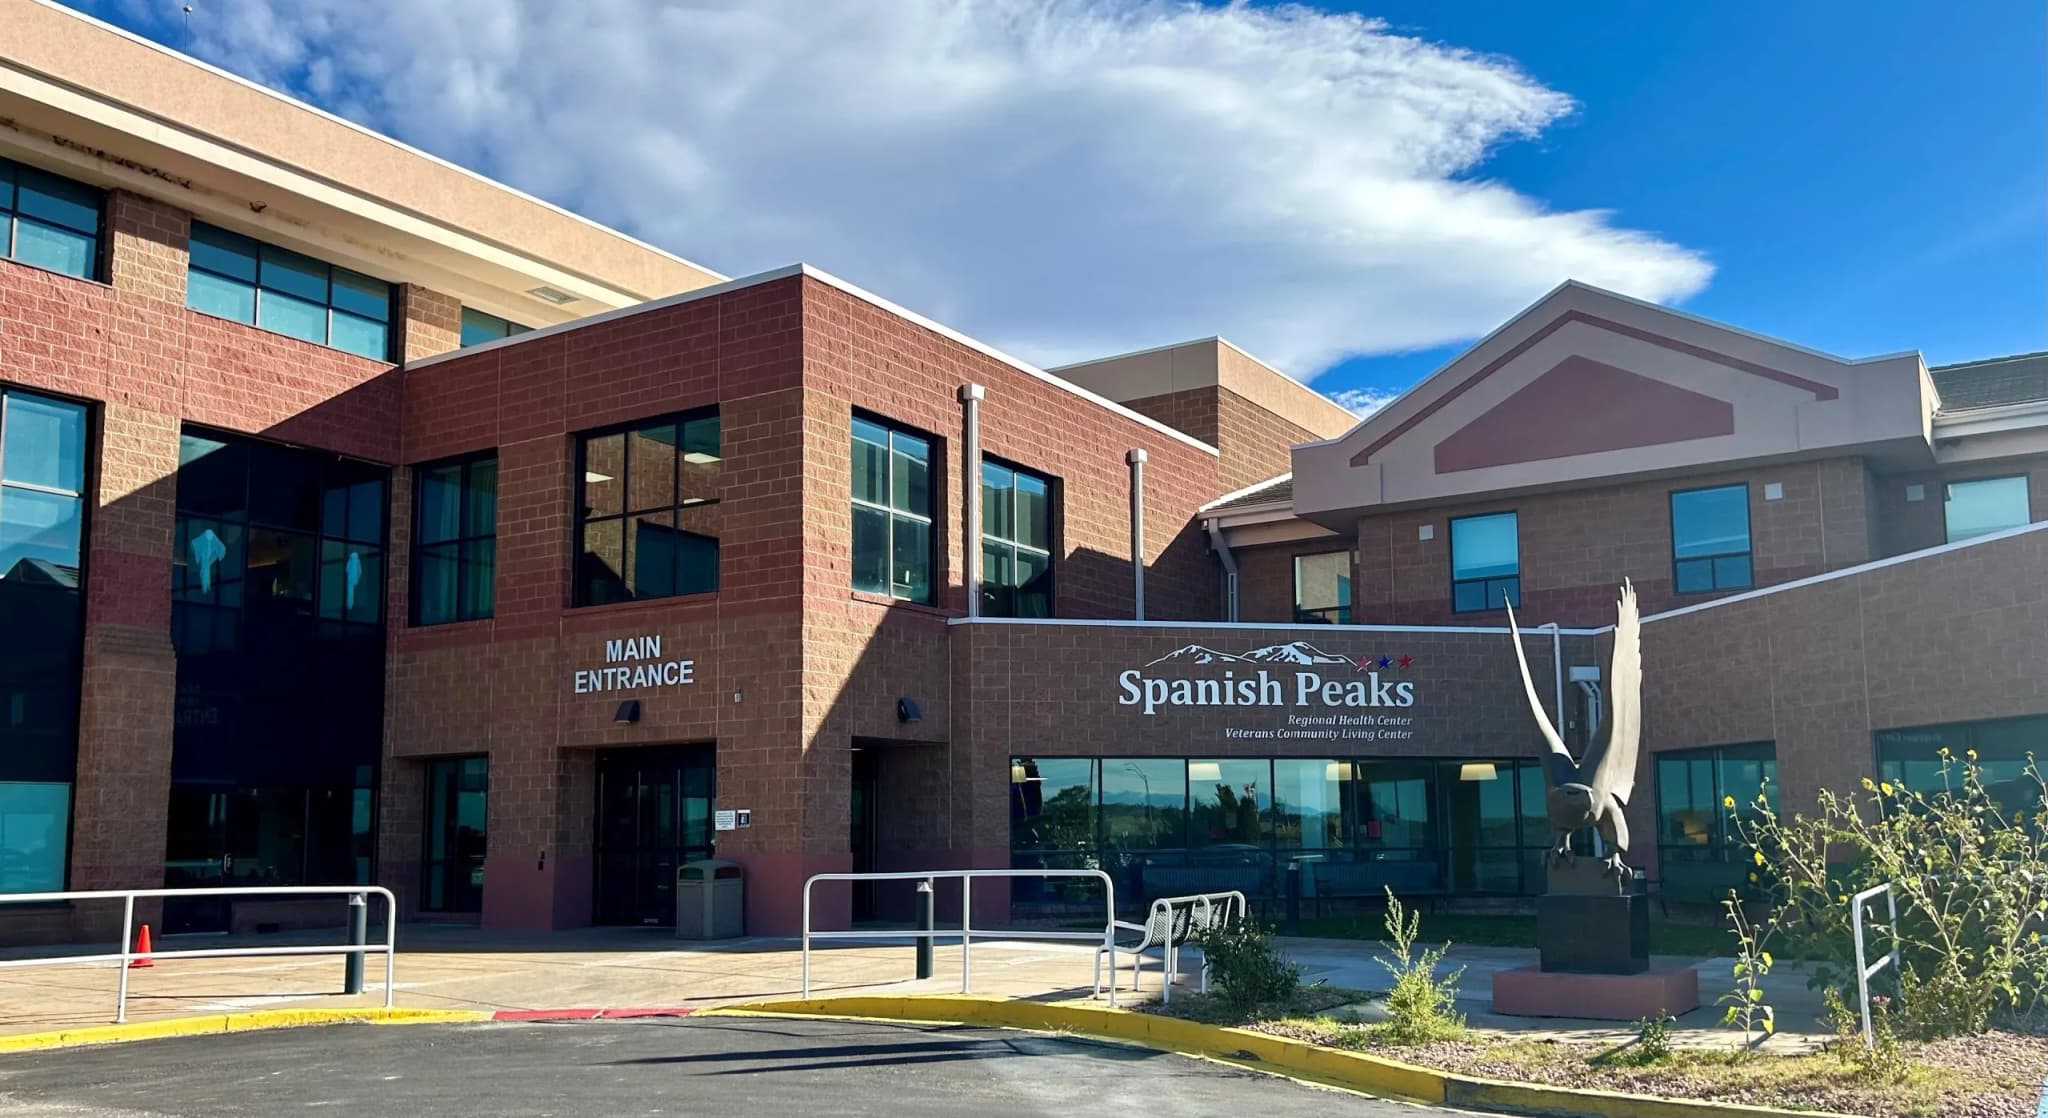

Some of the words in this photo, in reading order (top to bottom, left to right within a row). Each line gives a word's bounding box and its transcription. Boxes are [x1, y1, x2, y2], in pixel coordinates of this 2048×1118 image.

[606, 635, 661, 662] MAIN
[575, 660, 694, 693] ENTRANCE
[1119, 670, 1284, 715] Spanish
[1295, 672, 1415, 707] Peaks
[1225, 727, 1275, 738] Veterans
[1277, 728, 1339, 741] Community
[1342, 728, 1375, 741] Living
[1377, 728, 1413, 740] Center
[1288, 715, 1337, 727] Regional
[1339, 715, 1375, 726] Health
[1377, 715, 1413, 726] Center
